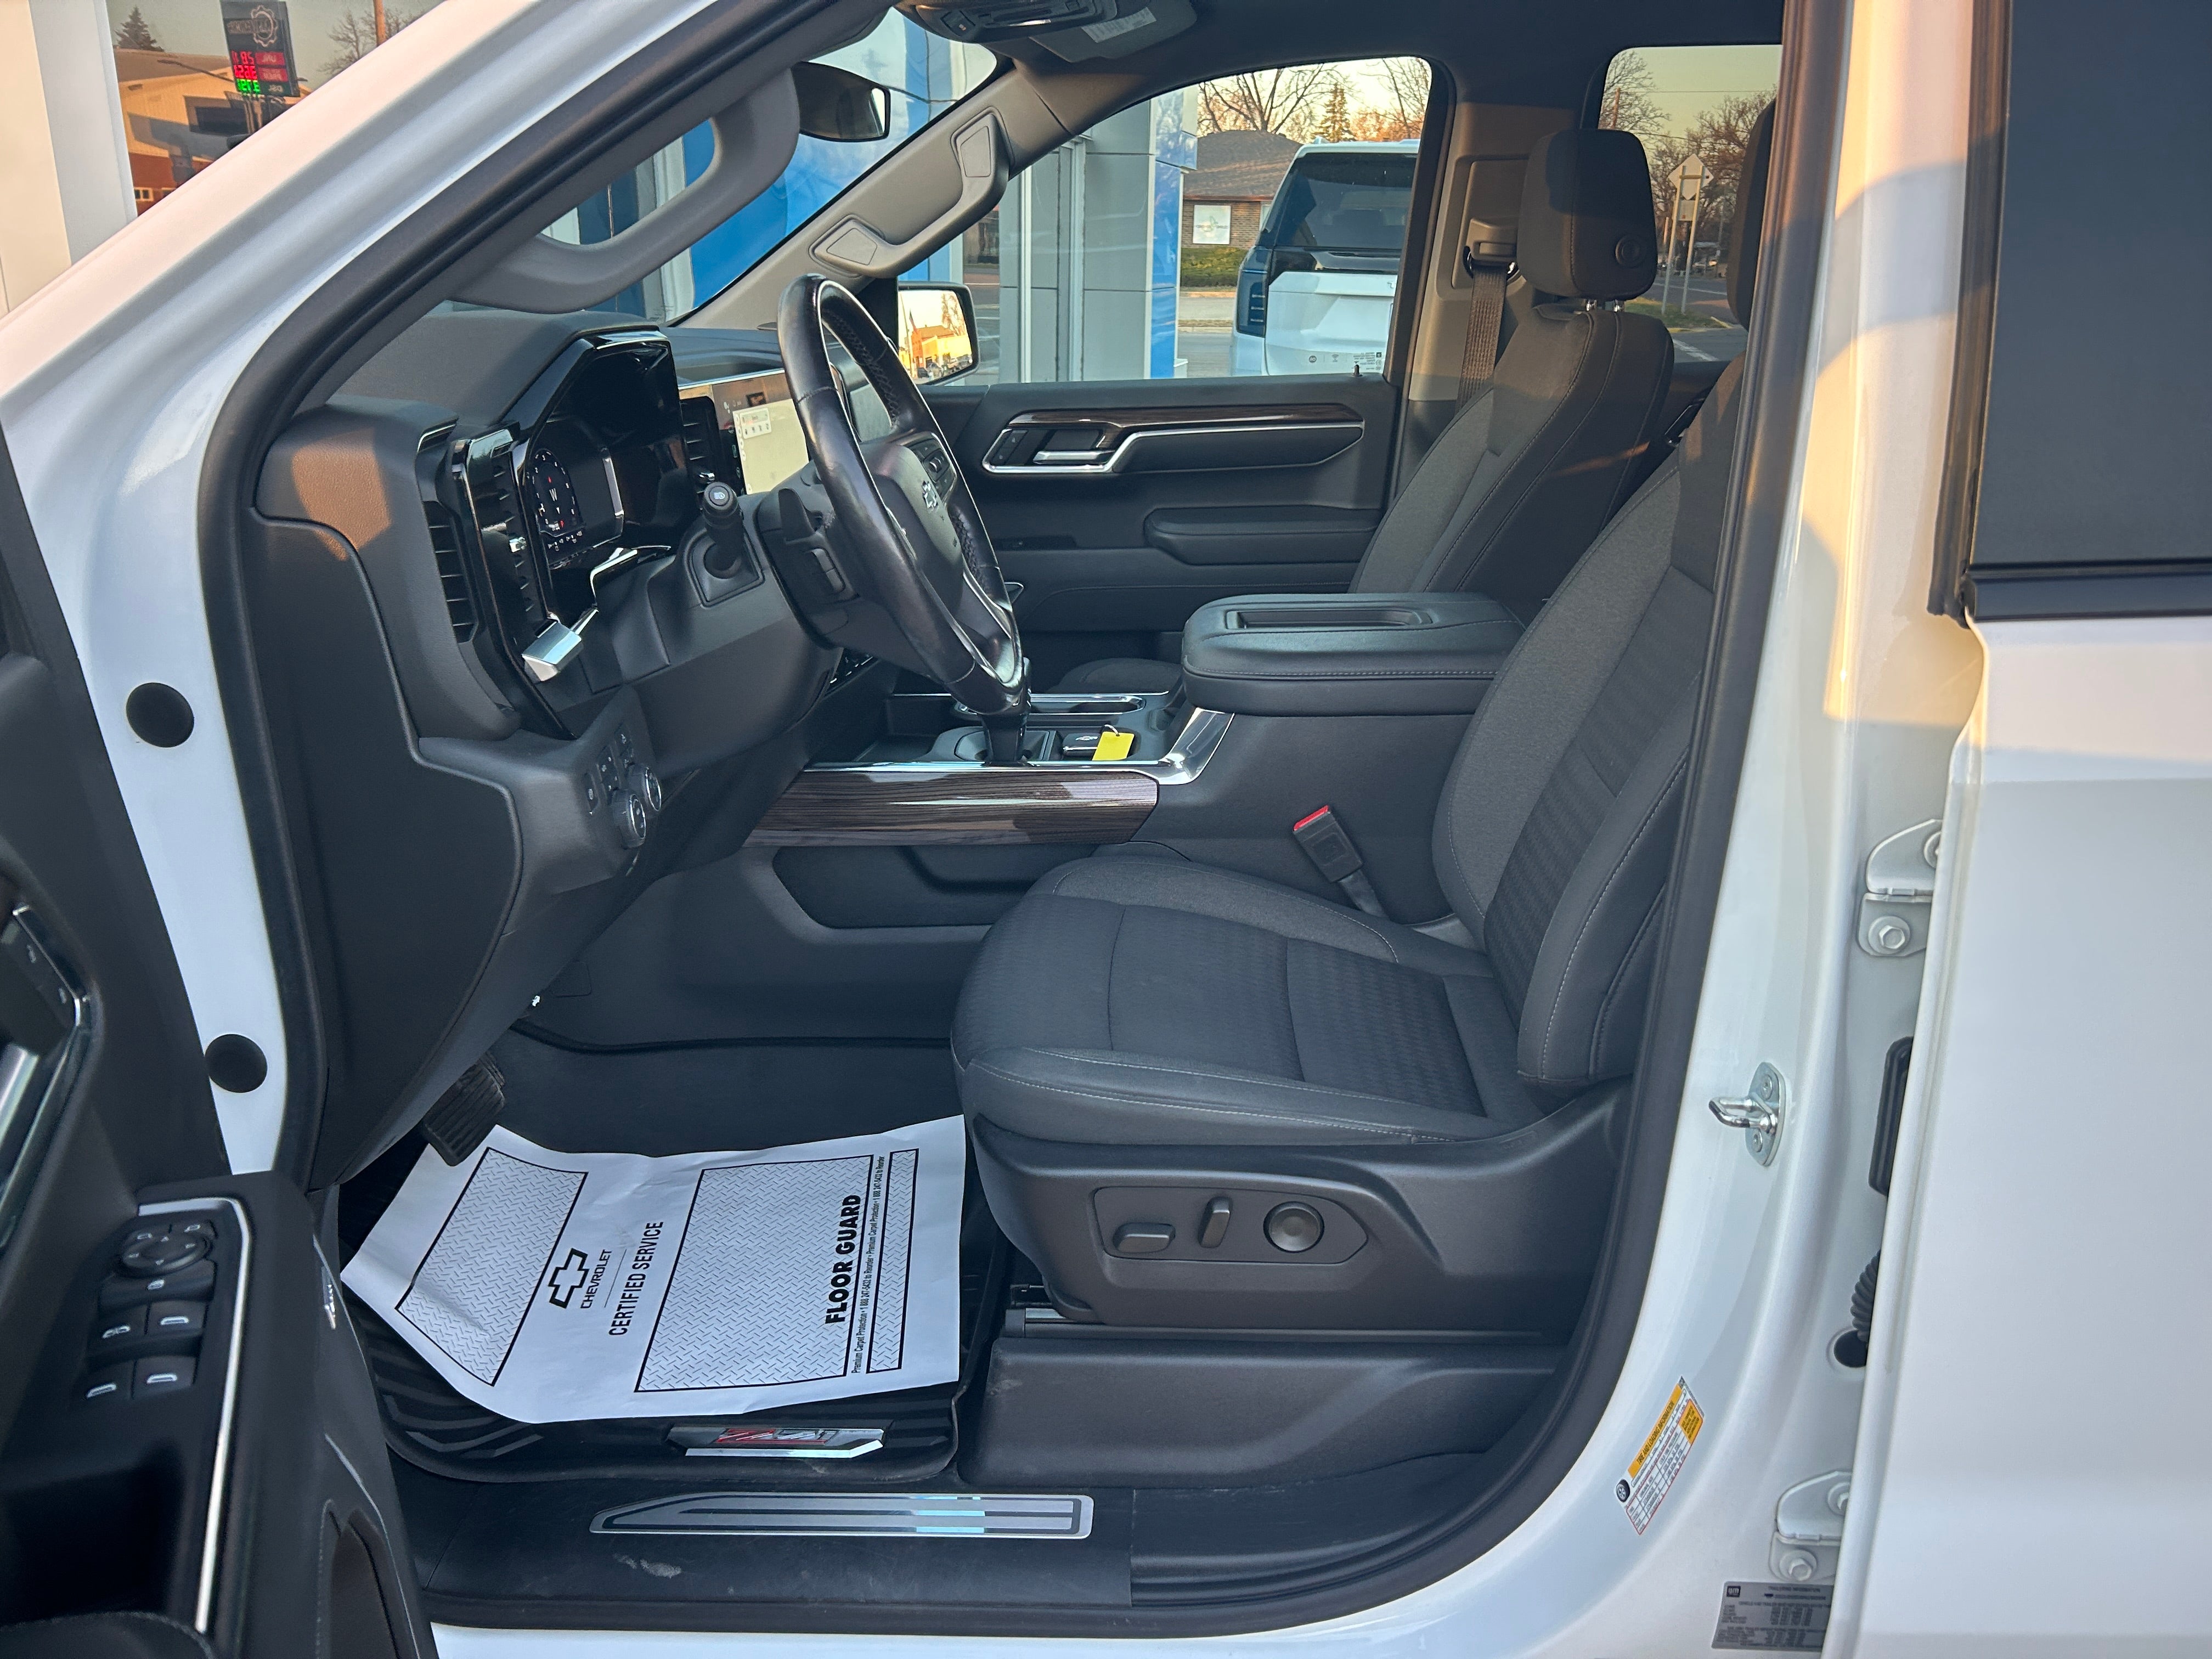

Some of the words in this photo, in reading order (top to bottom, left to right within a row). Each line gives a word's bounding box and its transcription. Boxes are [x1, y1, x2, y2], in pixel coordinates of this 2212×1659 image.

[835, 1195, 861, 1255] GUARD
[580, 1249, 613, 1309] CHEVROLET
[608, 1273, 646, 1336] CERTIFIED
[631, 1221, 664, 1270] SERVICE
[825, 1260, 855, 1324] FLOOR
[854, 1336, 866, 1352] Carpet
[856, 1313, 867, 1336] Protection
[851, 1352, 863, 1374] Premium
[715, 1427, 839, 1444] Z71
